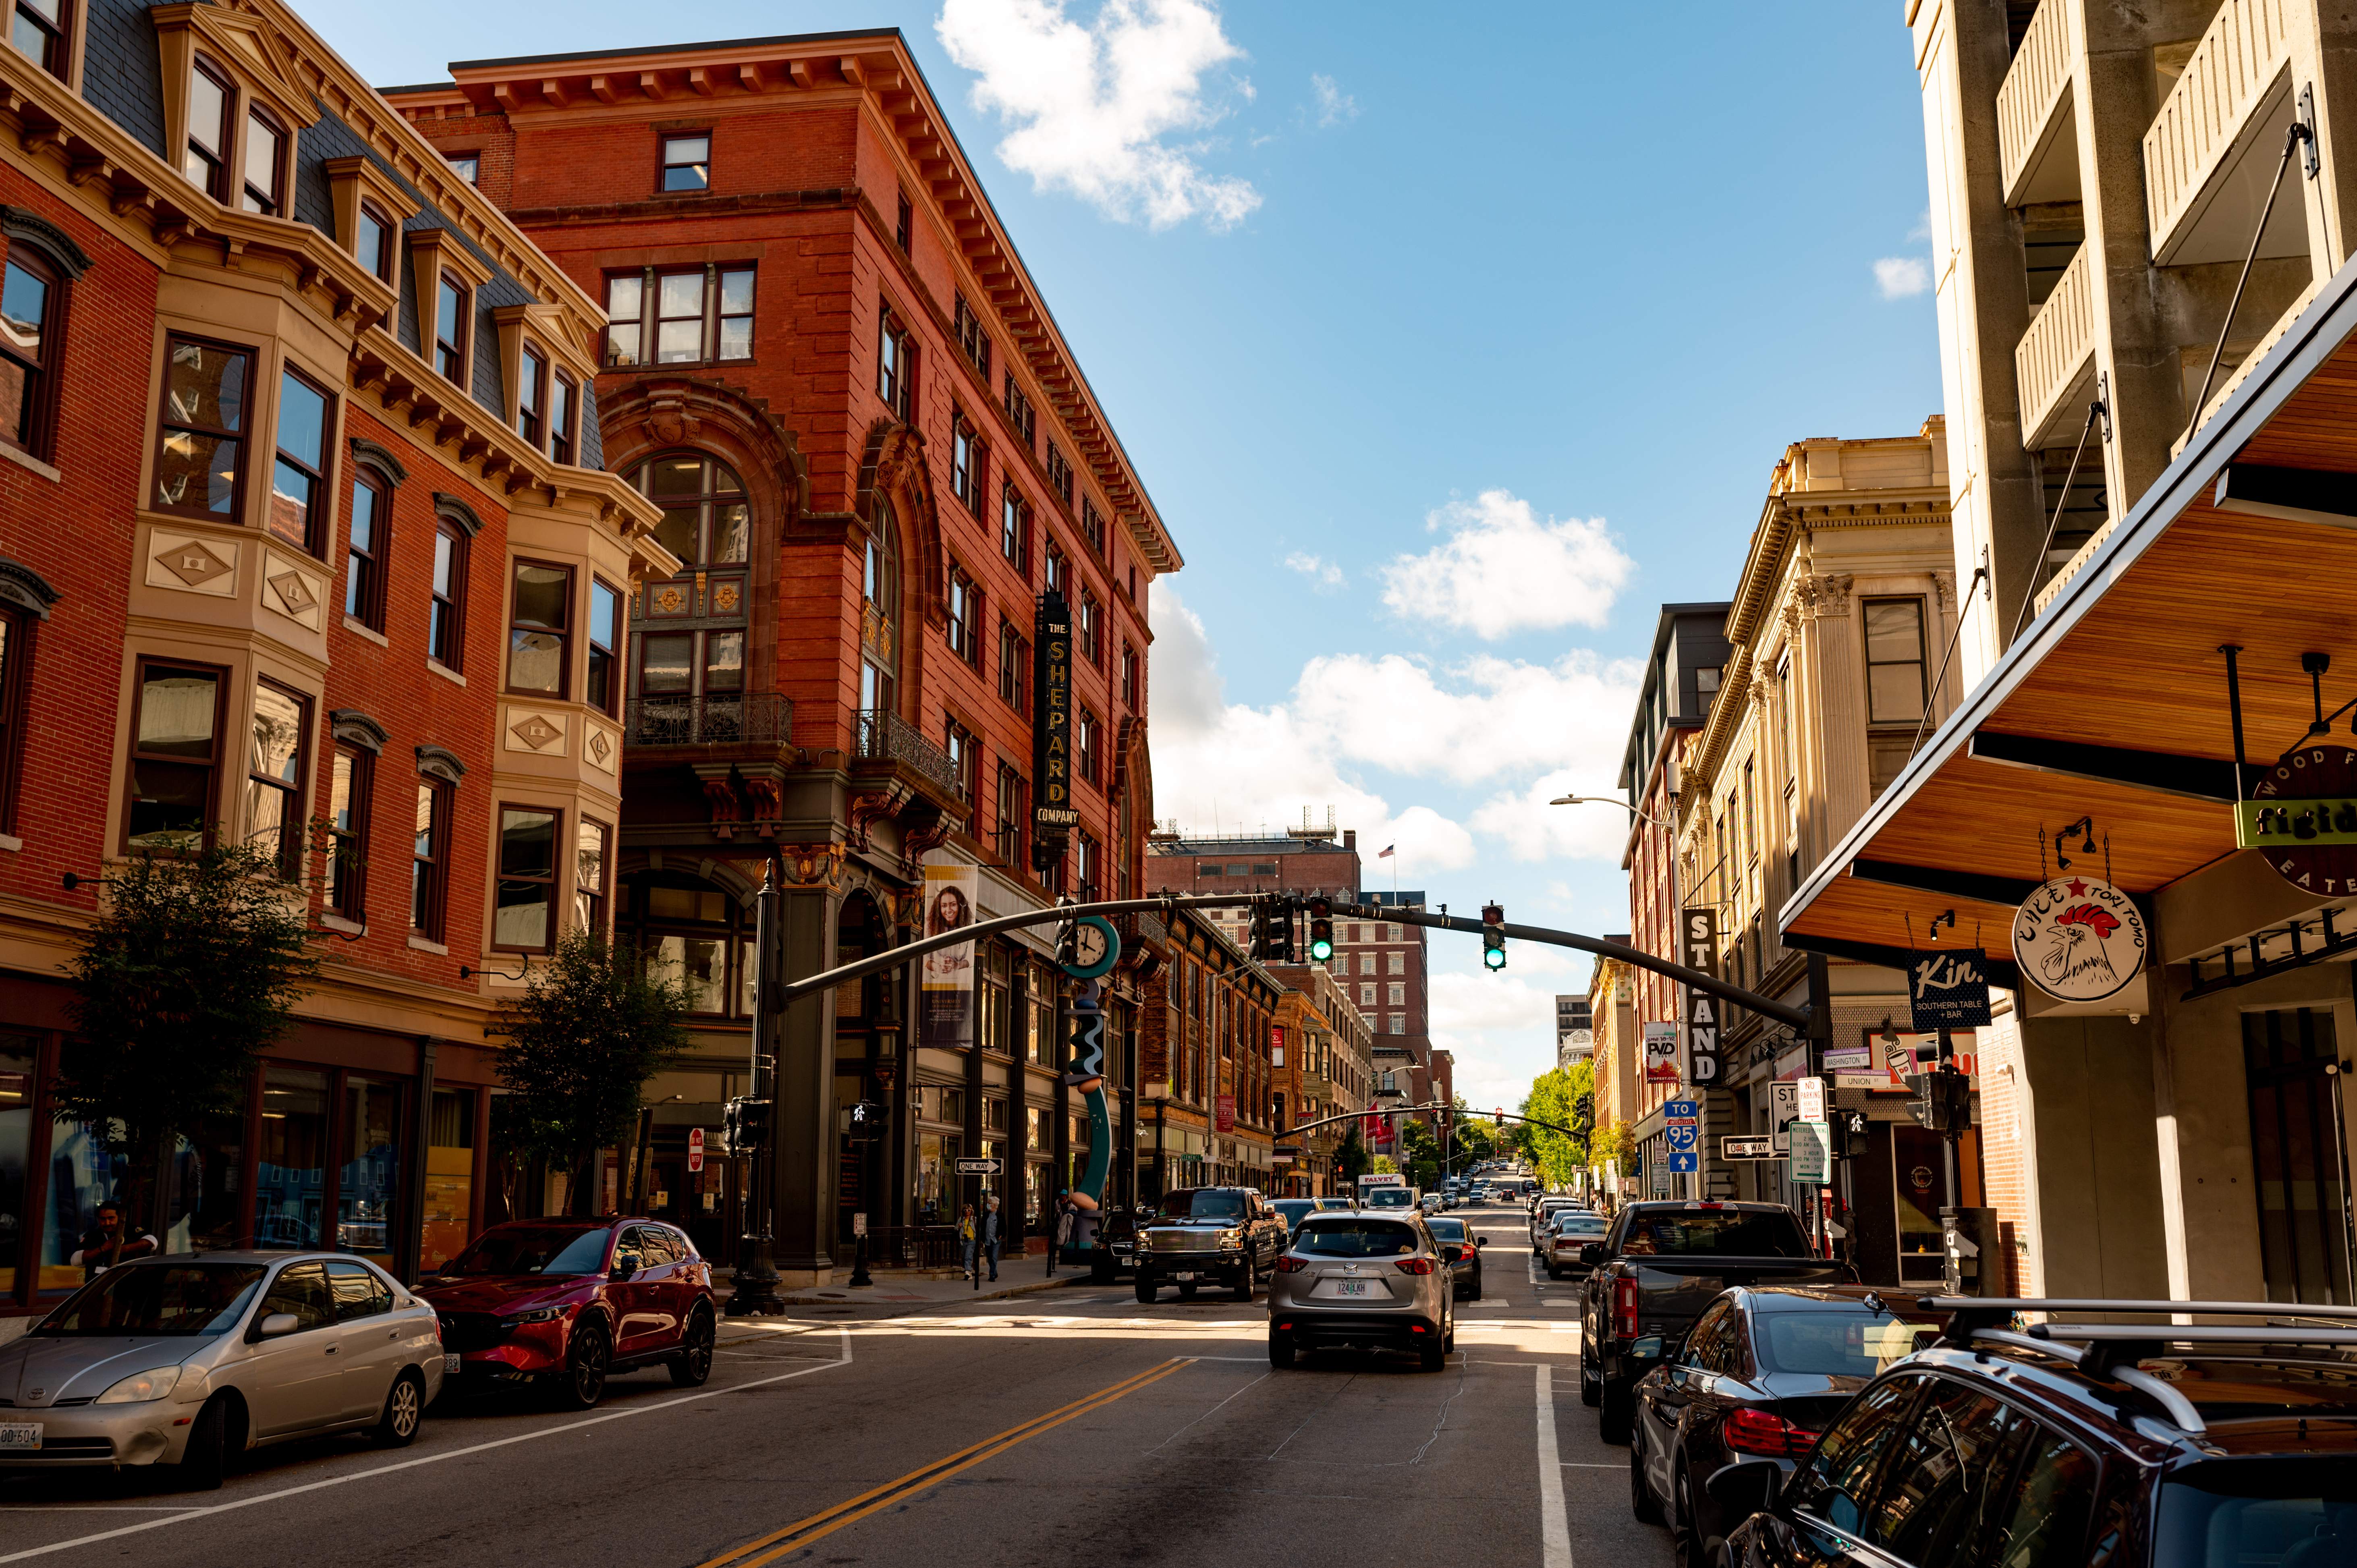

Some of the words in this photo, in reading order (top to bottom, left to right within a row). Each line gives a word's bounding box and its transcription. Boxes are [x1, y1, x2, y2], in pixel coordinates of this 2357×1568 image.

[1048, 623, 1066, 634] THE
[1048, 641, 1066, 803] SHEPARD
[2262, 750, 2324, 795] WOOD
[1037, 808, 1079, 824] COMPANY
[2091, 887, 2125, 909] TORI
[2123, 908, 2145, 948] TOMO
[1691, 916, 1716, 1079] STAND
[1917, 1002, 1957, 1010] SOUTHERN
[1647, 1043, 1675, 1055] PVD
[1826, 1057, 1860, 1066] WASHINGTON
[1778, 1089, 1795, 1101] ST
[1801, 1091, 1820, 1099] PARKING
[1672, 1104, 1689, 1114] TO
[1670, 1127, 1693, 1143] 95
[1731, 1144, 1746, 1152] OE
[1751, 1143, 1767, 1151] WAY
[1338, 1283, 1349, 1292] 124
[1353, 1284, 1365, 1292] LKH
